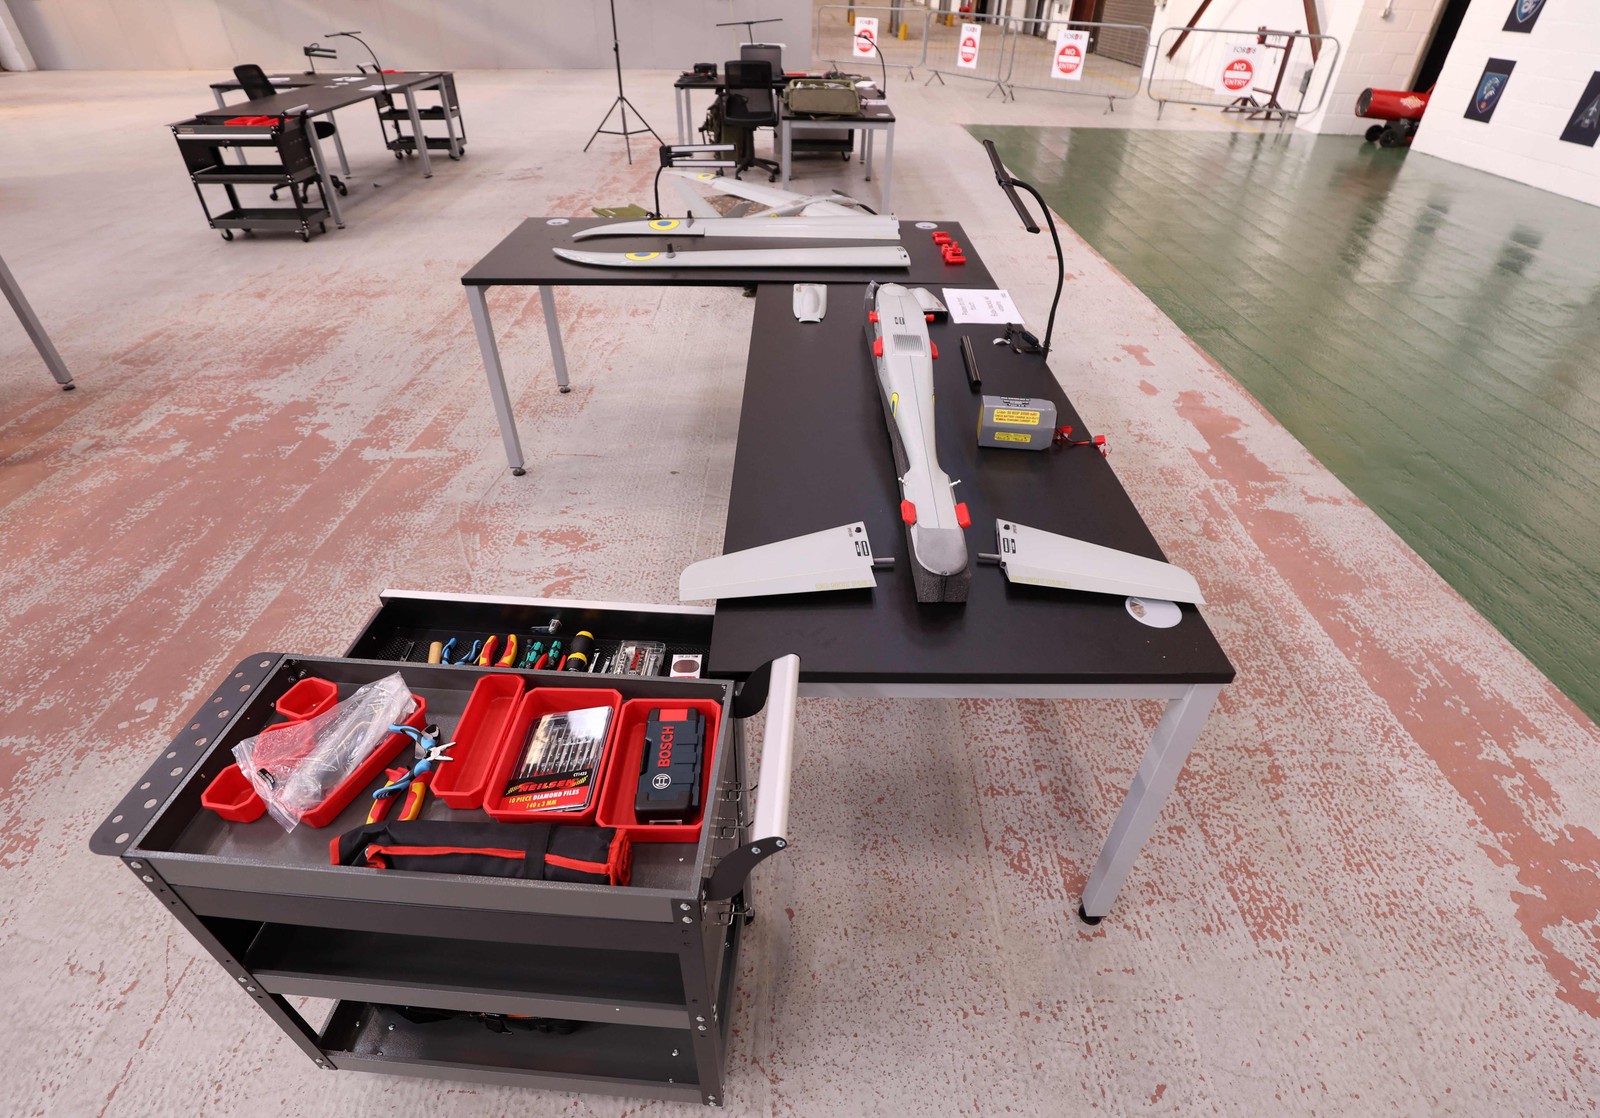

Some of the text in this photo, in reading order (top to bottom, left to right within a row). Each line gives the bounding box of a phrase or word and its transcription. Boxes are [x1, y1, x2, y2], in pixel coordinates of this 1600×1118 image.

[1064, 48, 1076, 56] NO
[1058, 62, 1077, 70] ENTRY
[1233, 62, 1247, 71] NO
[1225, 78, 1247, 86] ENTRY
[657, 725, 675, 768] BOSCH
[518, 777, 579, 794] NEILSEN
[515, 795, 533, 803] PIECE
[532, 791, 563, 801] DIAMOND
[563, 788, 580, 797] FILES
